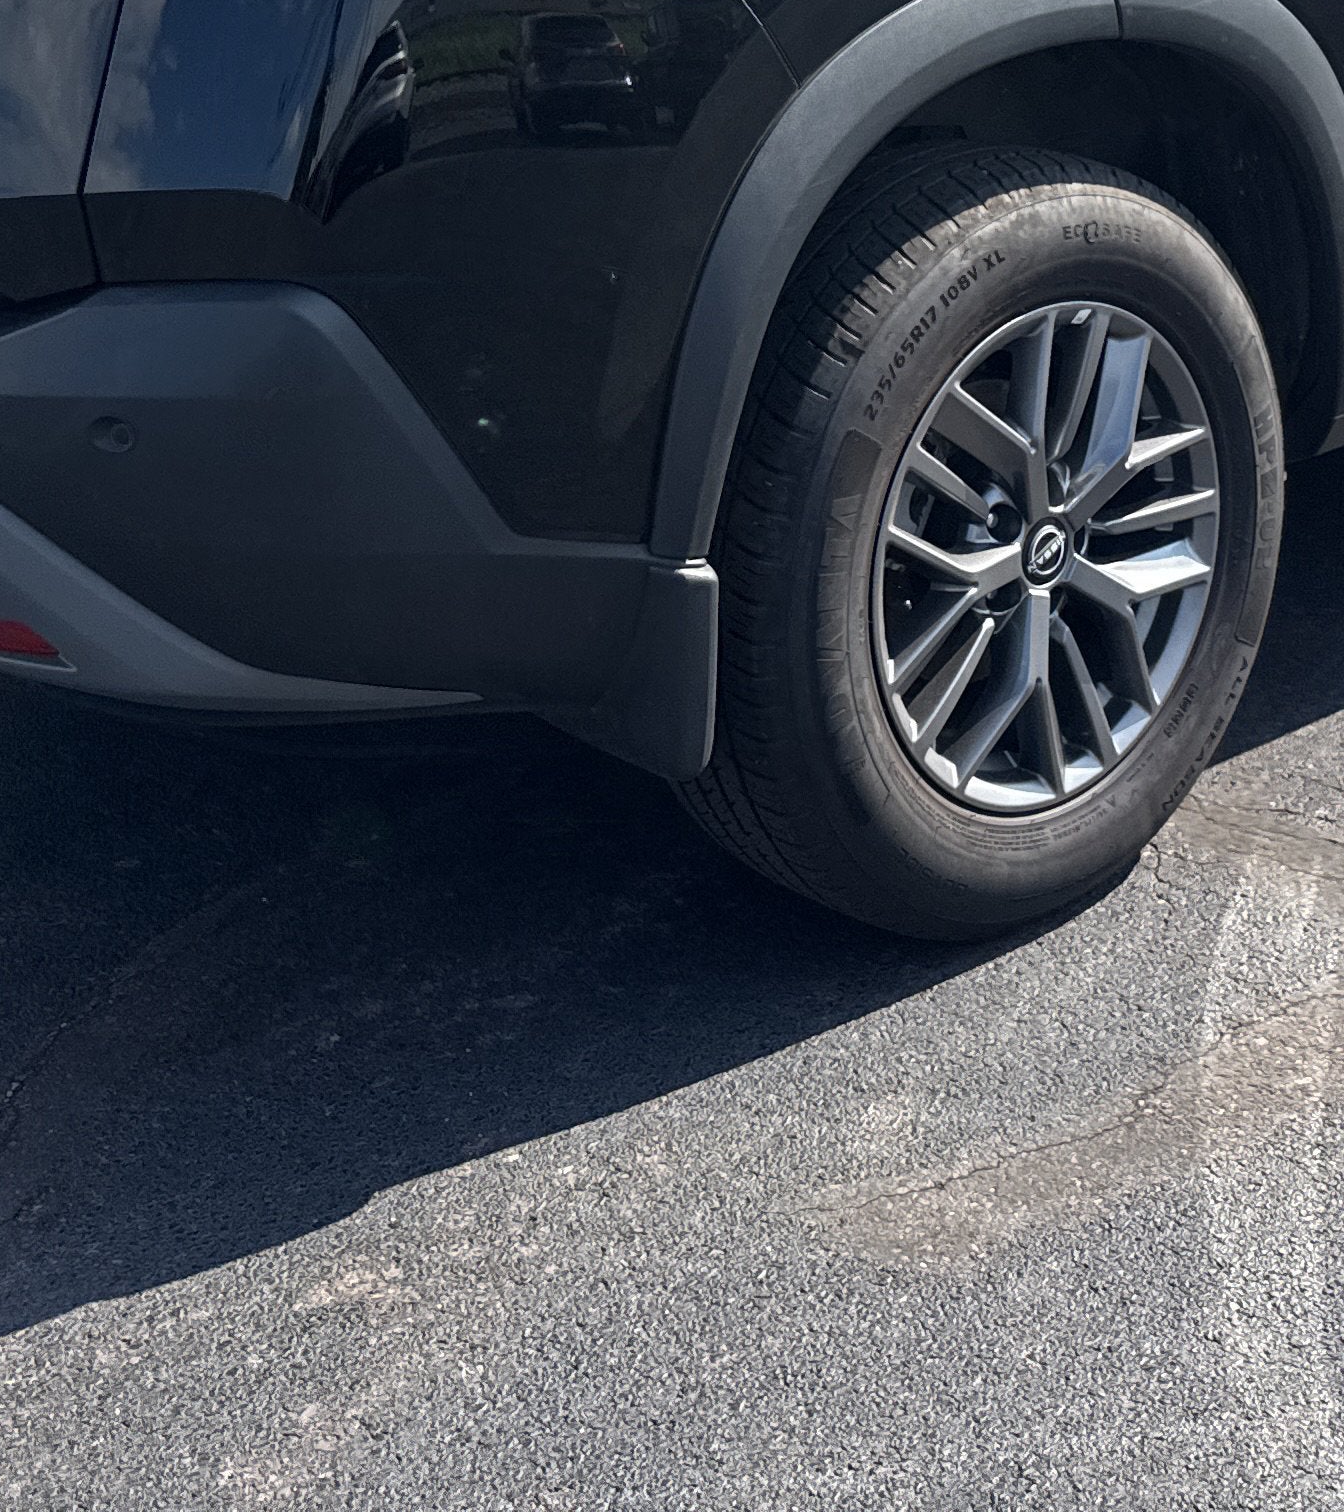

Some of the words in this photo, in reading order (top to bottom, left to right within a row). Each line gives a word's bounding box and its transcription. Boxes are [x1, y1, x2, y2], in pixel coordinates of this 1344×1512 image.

[863, 305, 938, 421] 235/65R17
[939, 265, 980, 309] 108V
[981, 249, 1007, 271] XL
